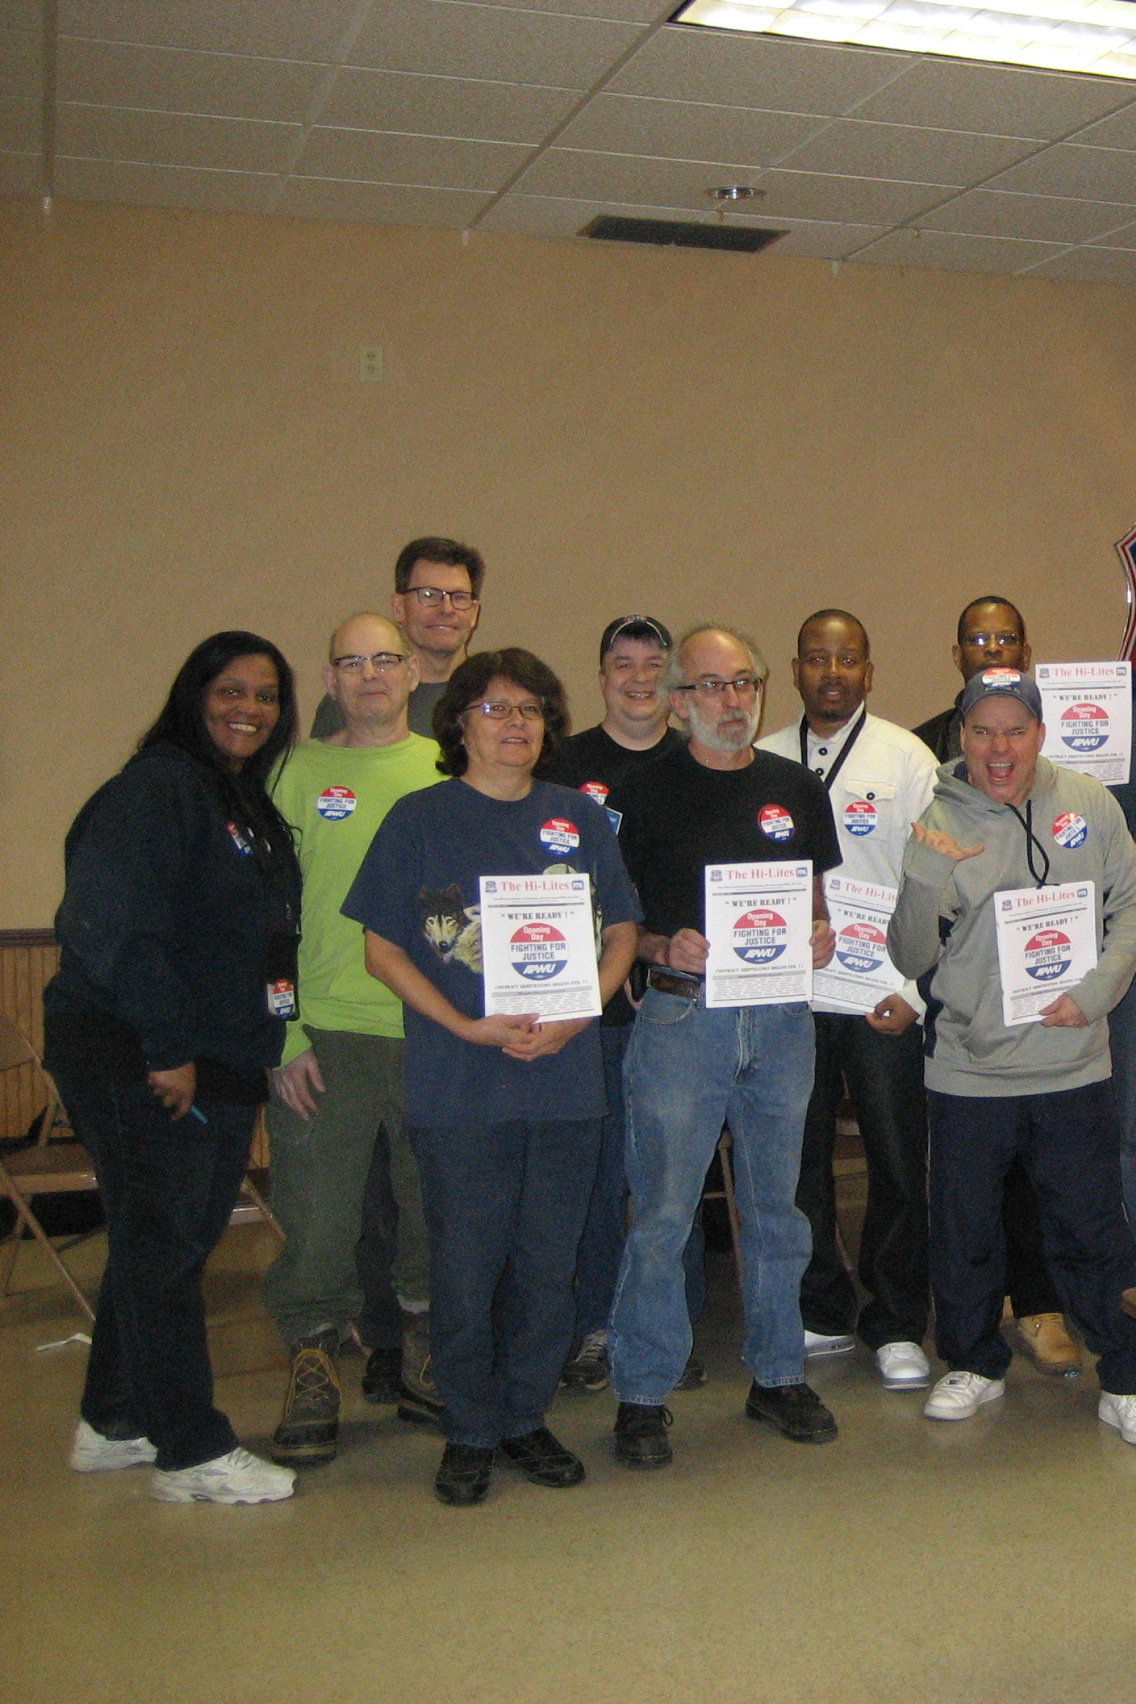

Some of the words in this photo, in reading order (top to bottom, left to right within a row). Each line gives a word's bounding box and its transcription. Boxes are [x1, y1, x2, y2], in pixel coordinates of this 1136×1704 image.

[1053, 668, 1073, 677] The
[1075, 667, 1115, 677] Hi-Lites
[1071, 738, 1100, 747] APWU
[726, 869, 750, 880] The
[752, 867, 794, 879] Hi-Lites
[500, 881, 521, 891] The
[525, 880, 569, 891] Hi-Lites
[844, 882, 863, 894] The
[760, 898, 785, 906] READY
[1015, 897, 1034, 908] The
[1036, 892, 1075, 905] Hi-Lites
[508, 912, 533, 920] WE'RE
[535, 911, 562, 920] READY
[843, 909, 866, 920] WE'RE
[868, 916, 890, 925] READ
[1021, 922, 1044, 931] WE'RE
[1045, 918, 1069, 928] READY
[733, 929, 769, 938] FIGHTING
[745, 936, 776, 945] JUSTICE
[838, 937, 871, 950] FIGHTING
[873, 943, 887, 953] FOR
[511, 944, 547, 952] FIGHTING
[550, 942, 566, 950] FOR
[846, 947, 875, 958] JUSTICE
[1025, 947, 1056, 960] FIGHTING
[1057, 944, 1071, 953] FOR
[522, 952, 555, 961] JUSTICE
[744, 948, 777, 959] APWU
[1034, 954, 1062, 965] JUSTICE
[523, 963, 556, 975] APWU
[1035, 963, 1063, 977] APWU
